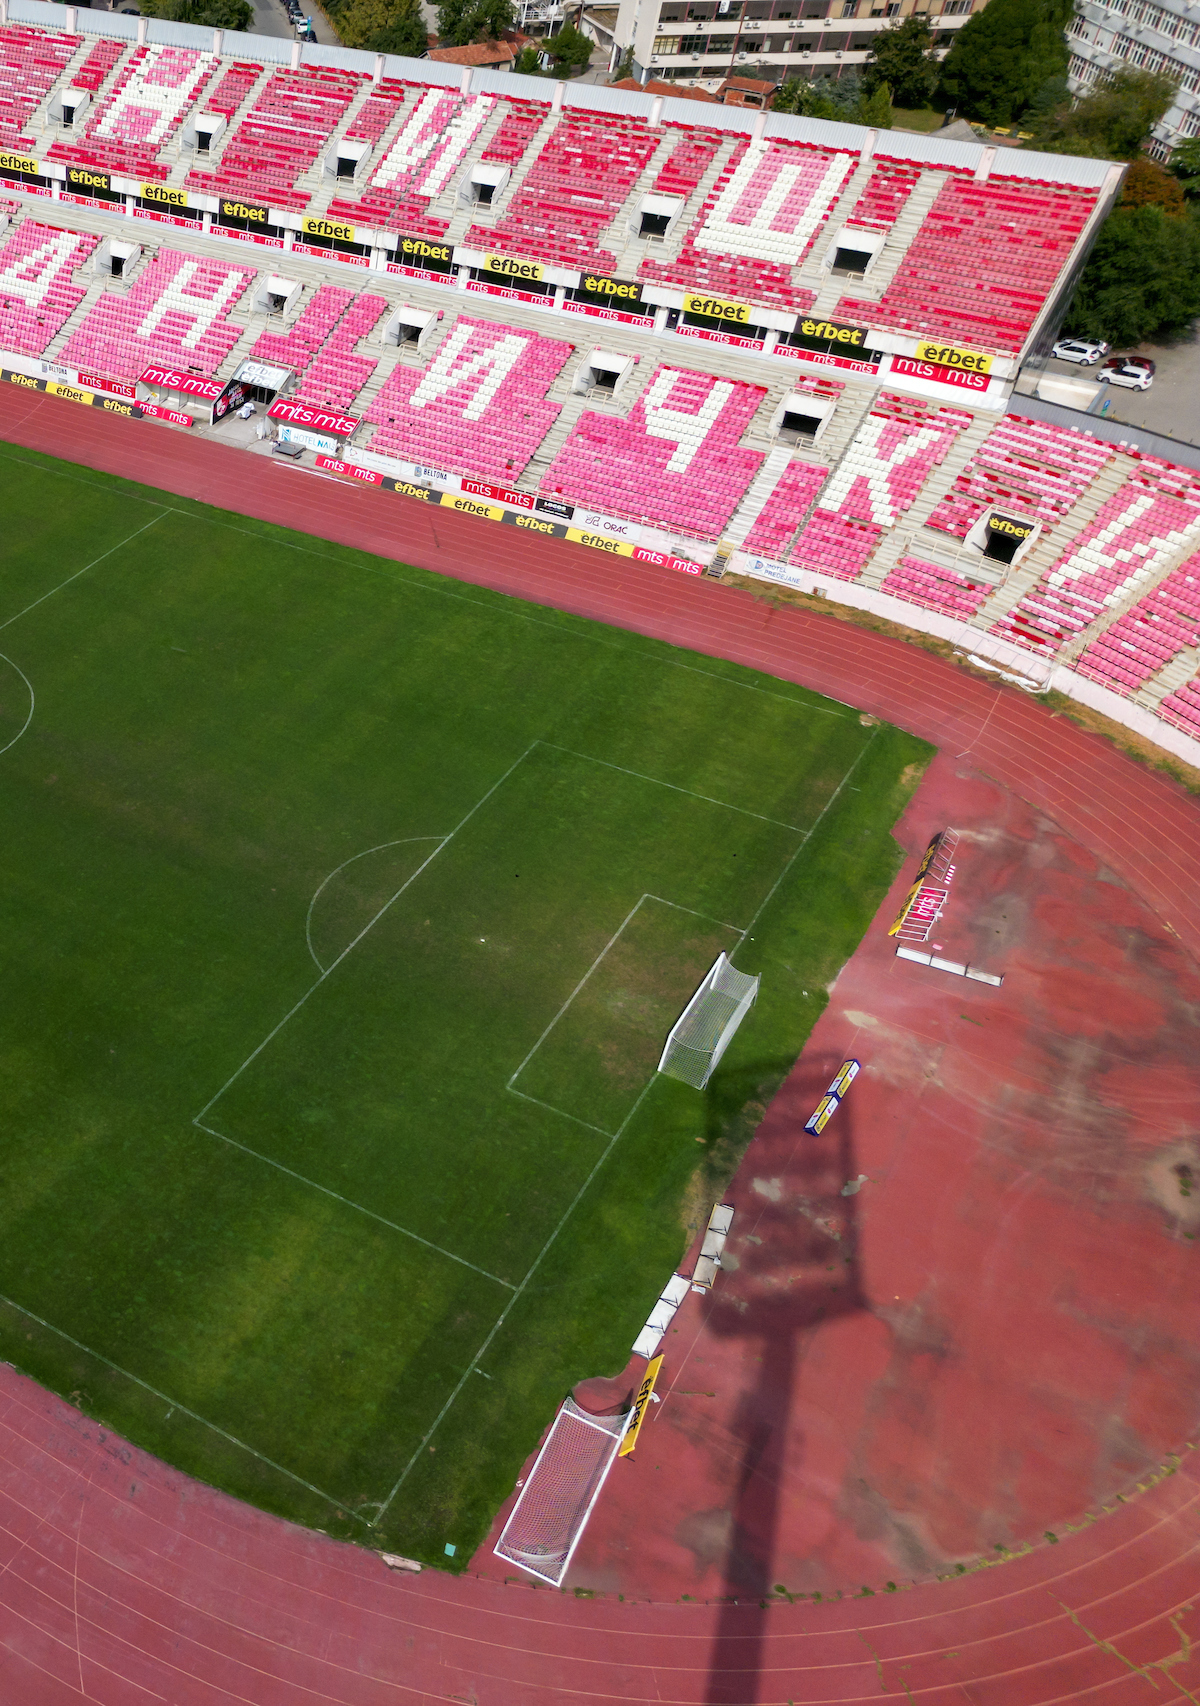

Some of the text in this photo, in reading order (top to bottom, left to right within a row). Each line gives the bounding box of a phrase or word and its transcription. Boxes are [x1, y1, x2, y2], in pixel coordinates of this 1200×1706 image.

[0, 155, 35, 172] efbet
[69, 169, 108, 188] efbet
[14, 183, 28, 192] mts
[36, 188, 50, 196] mts
[144, 186, 184, 204] efbet
[62, 193, 124, 214] mts mts mts
[222, 202, 266, 222] efbet
[136, 210, 200, 230] mts mts mts
[306, 220, 350, 240] efbet
[213, 227, 281, 248] mts mts mts
[295, 244, 367, 266] mts mts mts
[402, 239, 450, 261] efbet
[388, 264, 458, 286] mts mts mts
[489, 256, 540, 278] efbet
[470, 282, 550, 306] mts mts mts
[584, 276, 639, 299] efbet
[566, 302, 652, 328] mts mts mts
[689, 298, 746, 321] efbet
[679, 326, 761, 351] mts mts mts
[801, 320, 863, 345] efbet
[777, 345, 873, 374] mts mts mts
[923, 345, 987, 370] efbet
[11, 374, 38, 389] efbet
[143, 367, 181, 387] mts
[183, 378, 222, 397] mts
[897, 358, 985, 388] mts mts
[56, 386, 84, 401] efbet
[82, 376, 102, 388] mts
[112, 384, 132, 397] mts
[103, 399, 133, 416] efbet
[139, 402, 188, 425] mts mts
[273, 402, 355, 432] mts mts
[294, 434, 316, 446] HOTEL
[323, 458, 345, 472] mts
[354, 468, 376, 482] mts
[423, 468, 447, 481] BELTONA
[394, 481, 430, 500] efbet
[466, 481, 530, 506] mts mts
[454, 498, 491, 517] efbet
[515, 515, 555, 534] efbet
[989, 518, 1031, 538] efbet
[580, 534, 620, 552] efbet
[637, 548, 700, 575] mts mts
[764, 569, 801, 584] PREDEJANE
[627, 1376, 654, 1434] efbet
